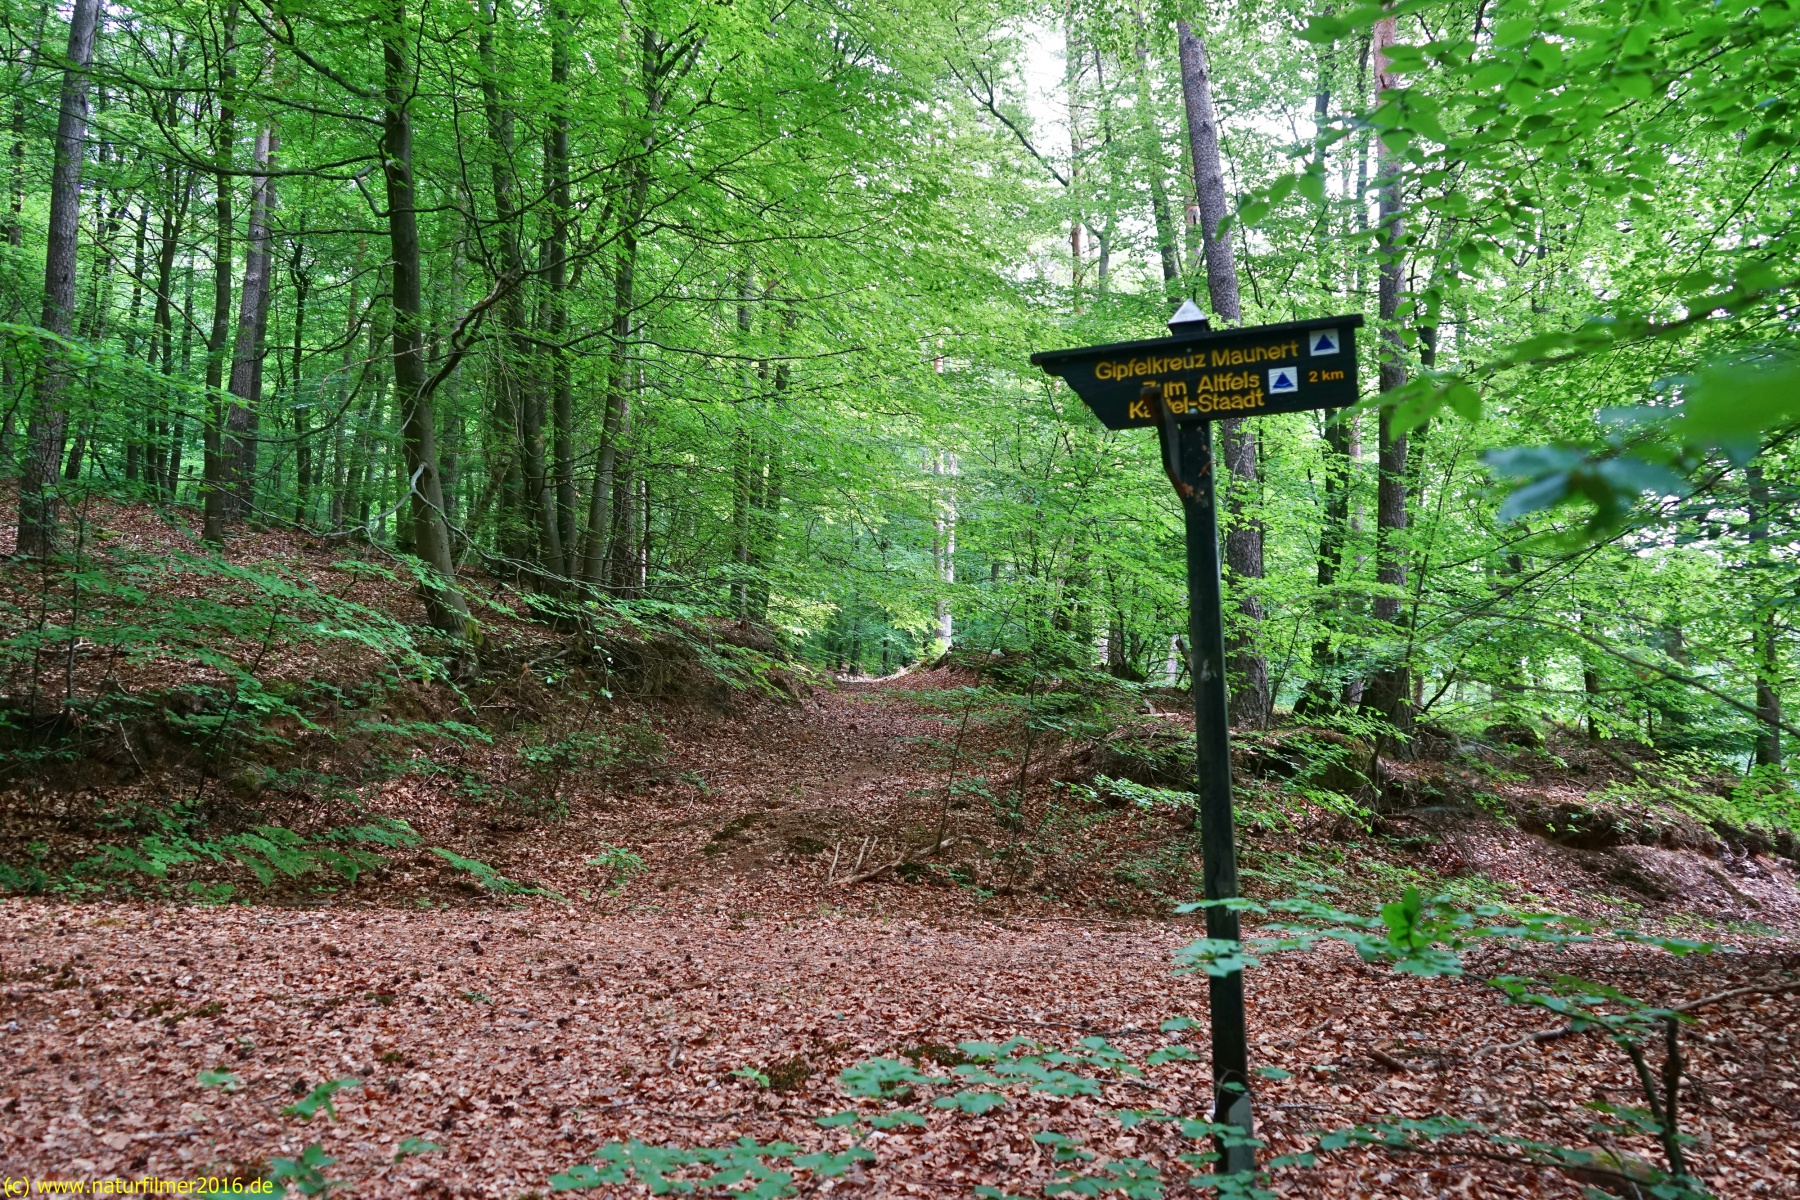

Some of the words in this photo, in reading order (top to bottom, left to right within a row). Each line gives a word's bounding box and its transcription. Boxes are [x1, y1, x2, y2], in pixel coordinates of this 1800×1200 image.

[1095, 353, 1206, 381] Gipfelkreuz
[1211, 340, 1298, 367] Maunert
[1197, 371, 1260, 394] Altfels
[1308, 370, 1319, 382] 2
[1321, 368, 1344, 382] km
